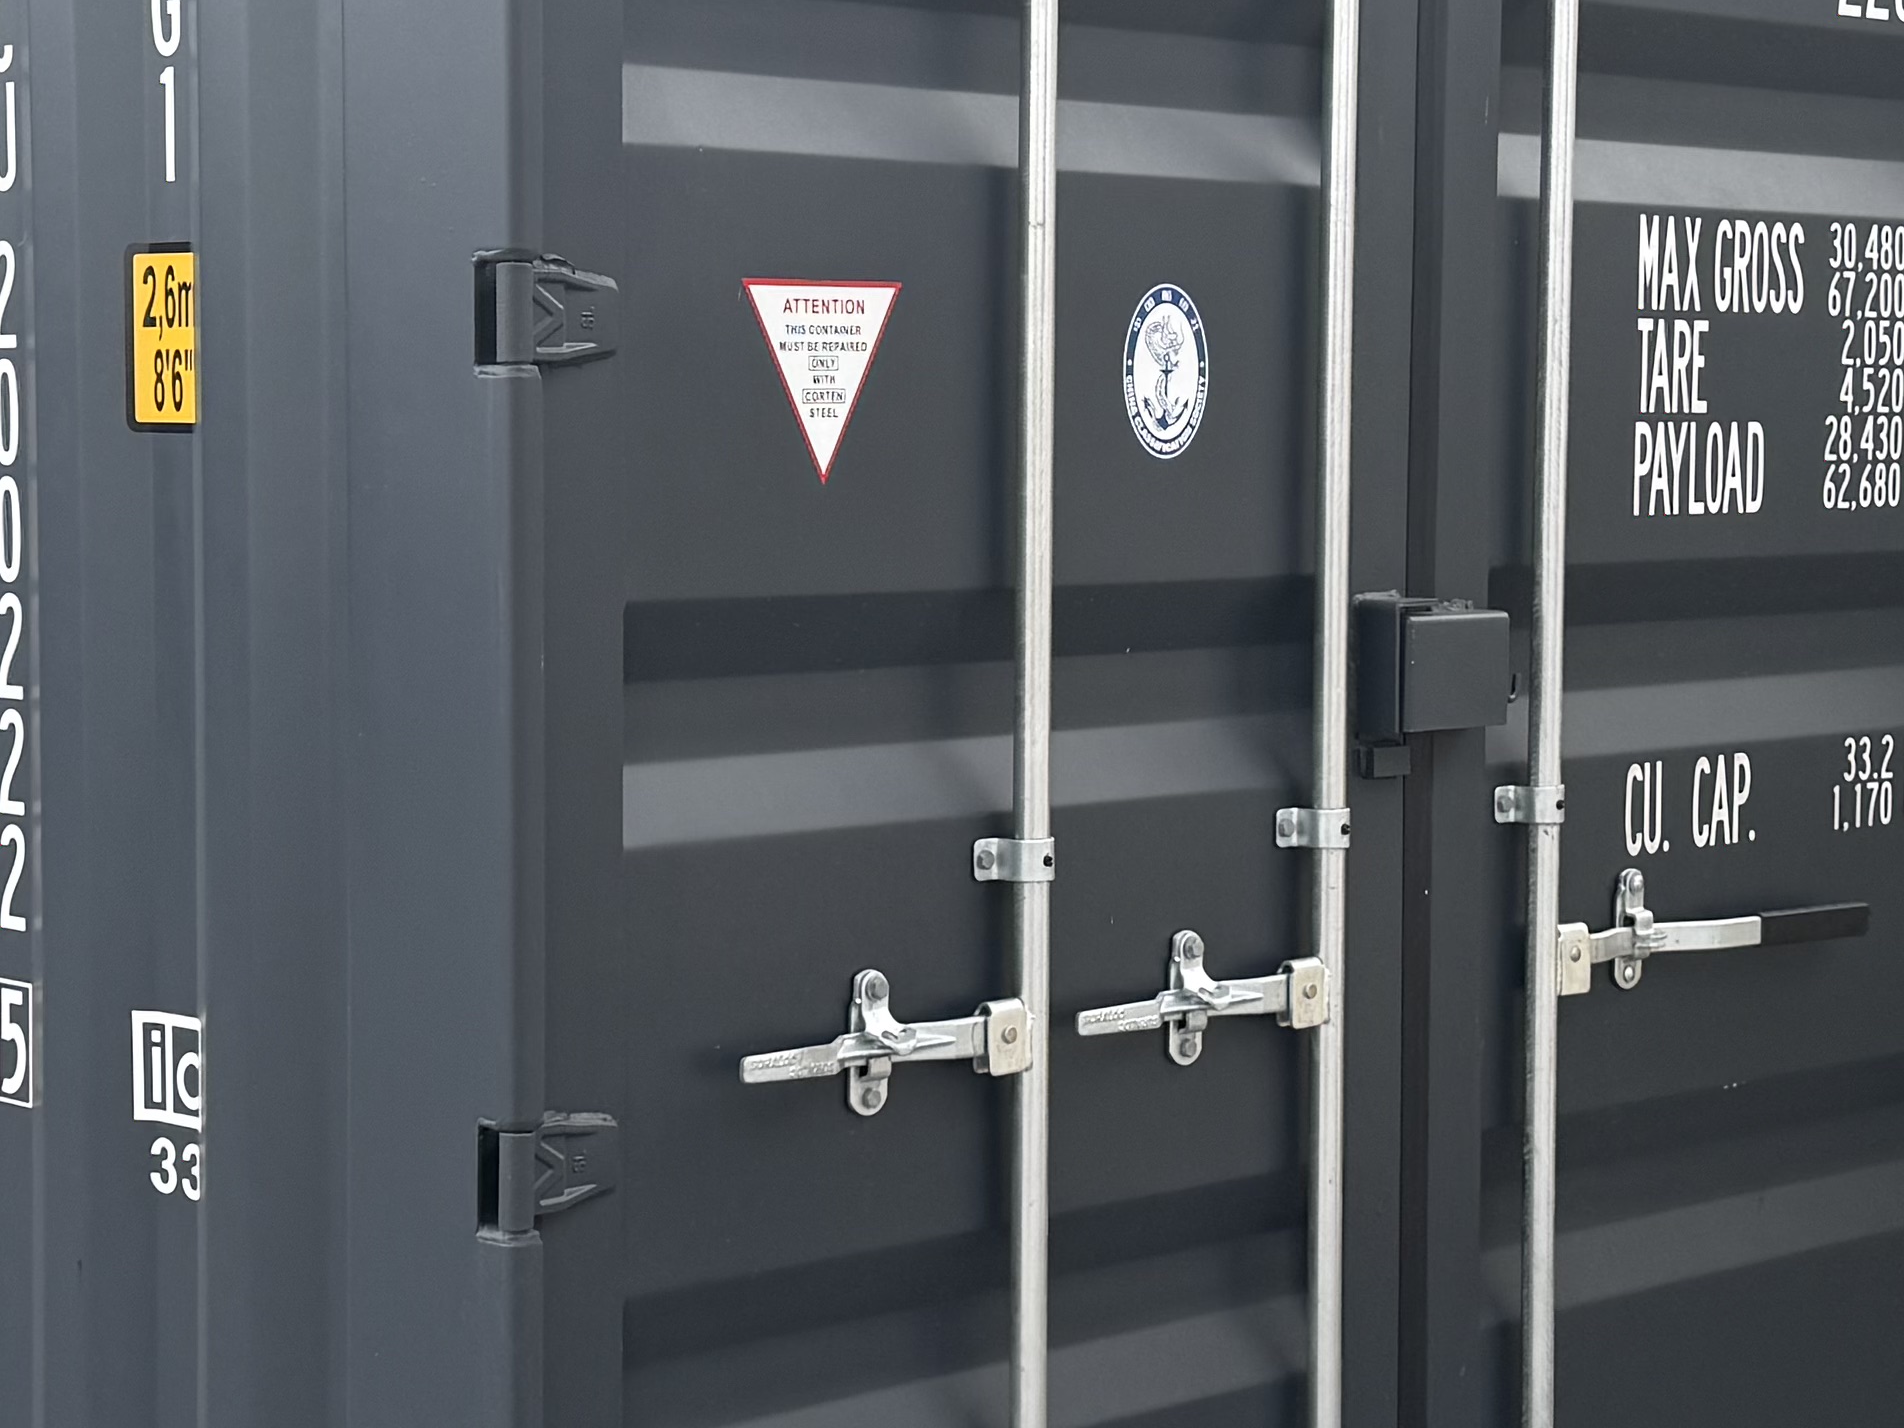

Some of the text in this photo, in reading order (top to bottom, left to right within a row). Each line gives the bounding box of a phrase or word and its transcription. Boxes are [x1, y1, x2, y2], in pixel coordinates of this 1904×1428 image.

[1637, 214, 1805, 314] MAX GROSS
[783, 298, 865, 314] ATTENTION
[785, 324, 862, 336] THIS CONTAINER
[779, 341, 867, 352] MUST BE REPAIRED
[811, 358, 836, 369] ONLY
[1637, 318, 1709, 414] TARE
[804, 391, 843, 402] CORTEN
[813, 375, 836, 384] WITH
[1839, 368, 1904, 414] 4,520
[809, 408, 839, 418] STEEL
[1824, 415, 1903, 463] 28,430
[1633, 421, 1765, 516] PAYLOAD
[1822, 462, 1901, 511] 62,680
[1843, 734, 1894, 782] 33.2
[1624, 752, 1756, 856] CU. CAP.
[1832, 781, 1893, 832] 1,170
[150, 1137, 201, 1201] 33
